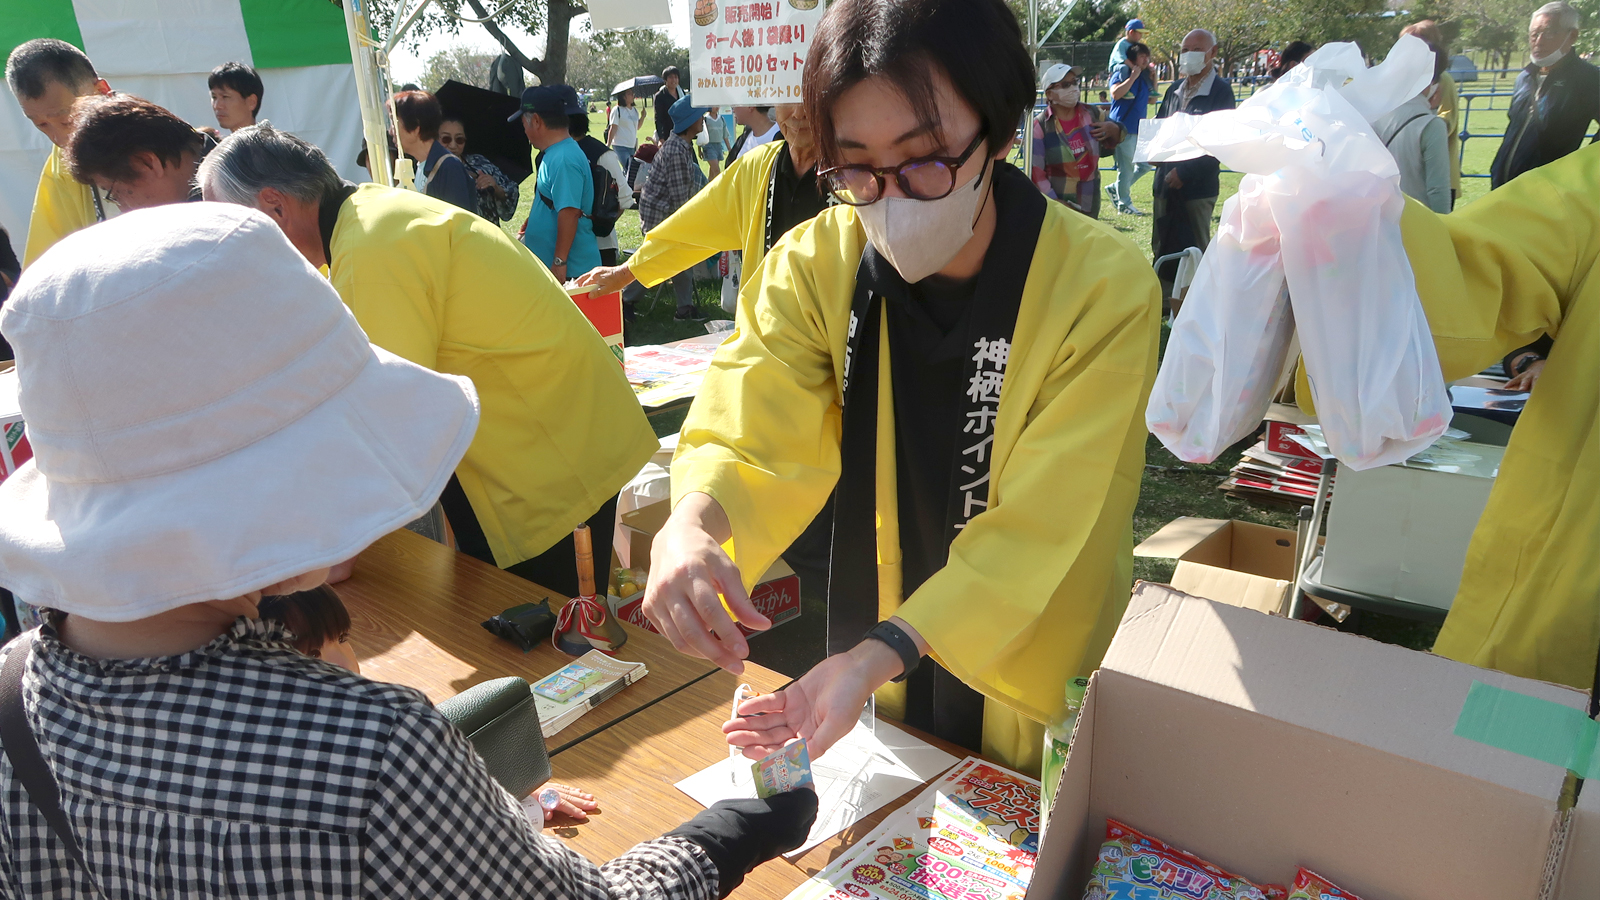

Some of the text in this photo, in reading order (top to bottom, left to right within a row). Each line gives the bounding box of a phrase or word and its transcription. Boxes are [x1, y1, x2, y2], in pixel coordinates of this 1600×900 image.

[724, 1, 780, 24] 販売開始！
[705, 24, 805, 50] お一人様1袋限り
[953, 336, 1011, 529] 神栖ポイント
[753, 587, 792, 614] みかん
[993, 783, 1041, 809] かみ
[960, 838, 1005, 861] コシヒカリ
[916, 852, 963, 880] 500
[1131, 857, 1210, 895] ビックリ!!
[958, 877, 999, 898] ポイントで
